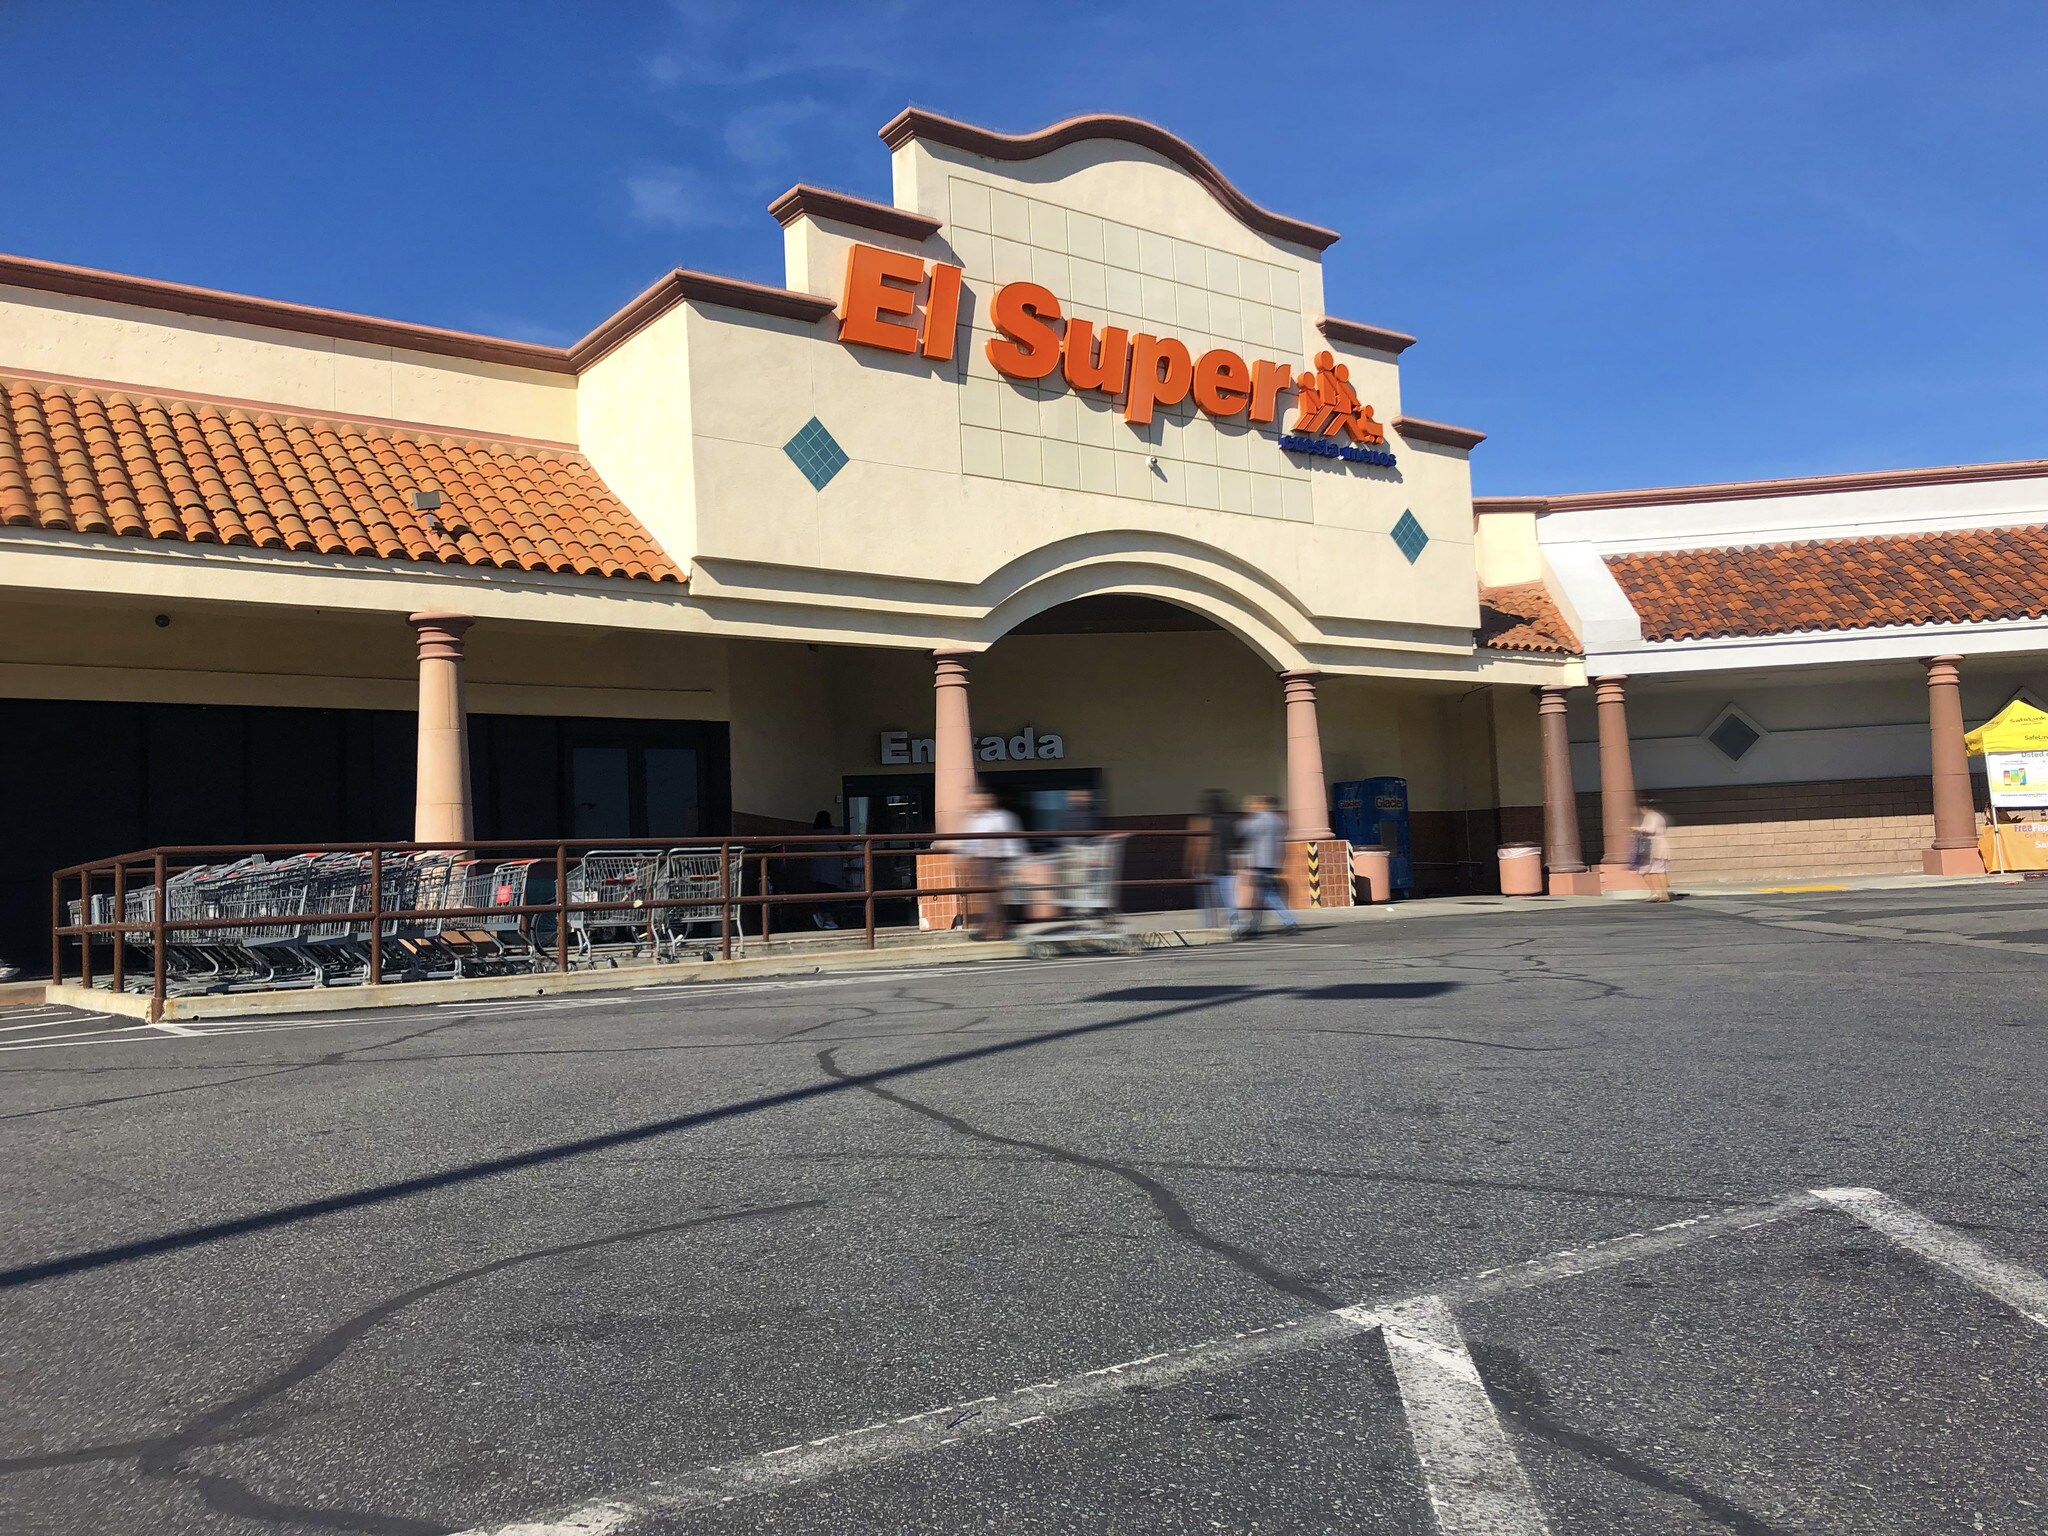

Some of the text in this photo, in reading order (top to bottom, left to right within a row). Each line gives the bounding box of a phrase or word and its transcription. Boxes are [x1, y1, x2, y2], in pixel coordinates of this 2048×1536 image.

[839, 244, 1292, 425] El Super
[880, 727, 1065, 765] Enada
[1375, 796, 1405, 809] Glacier
